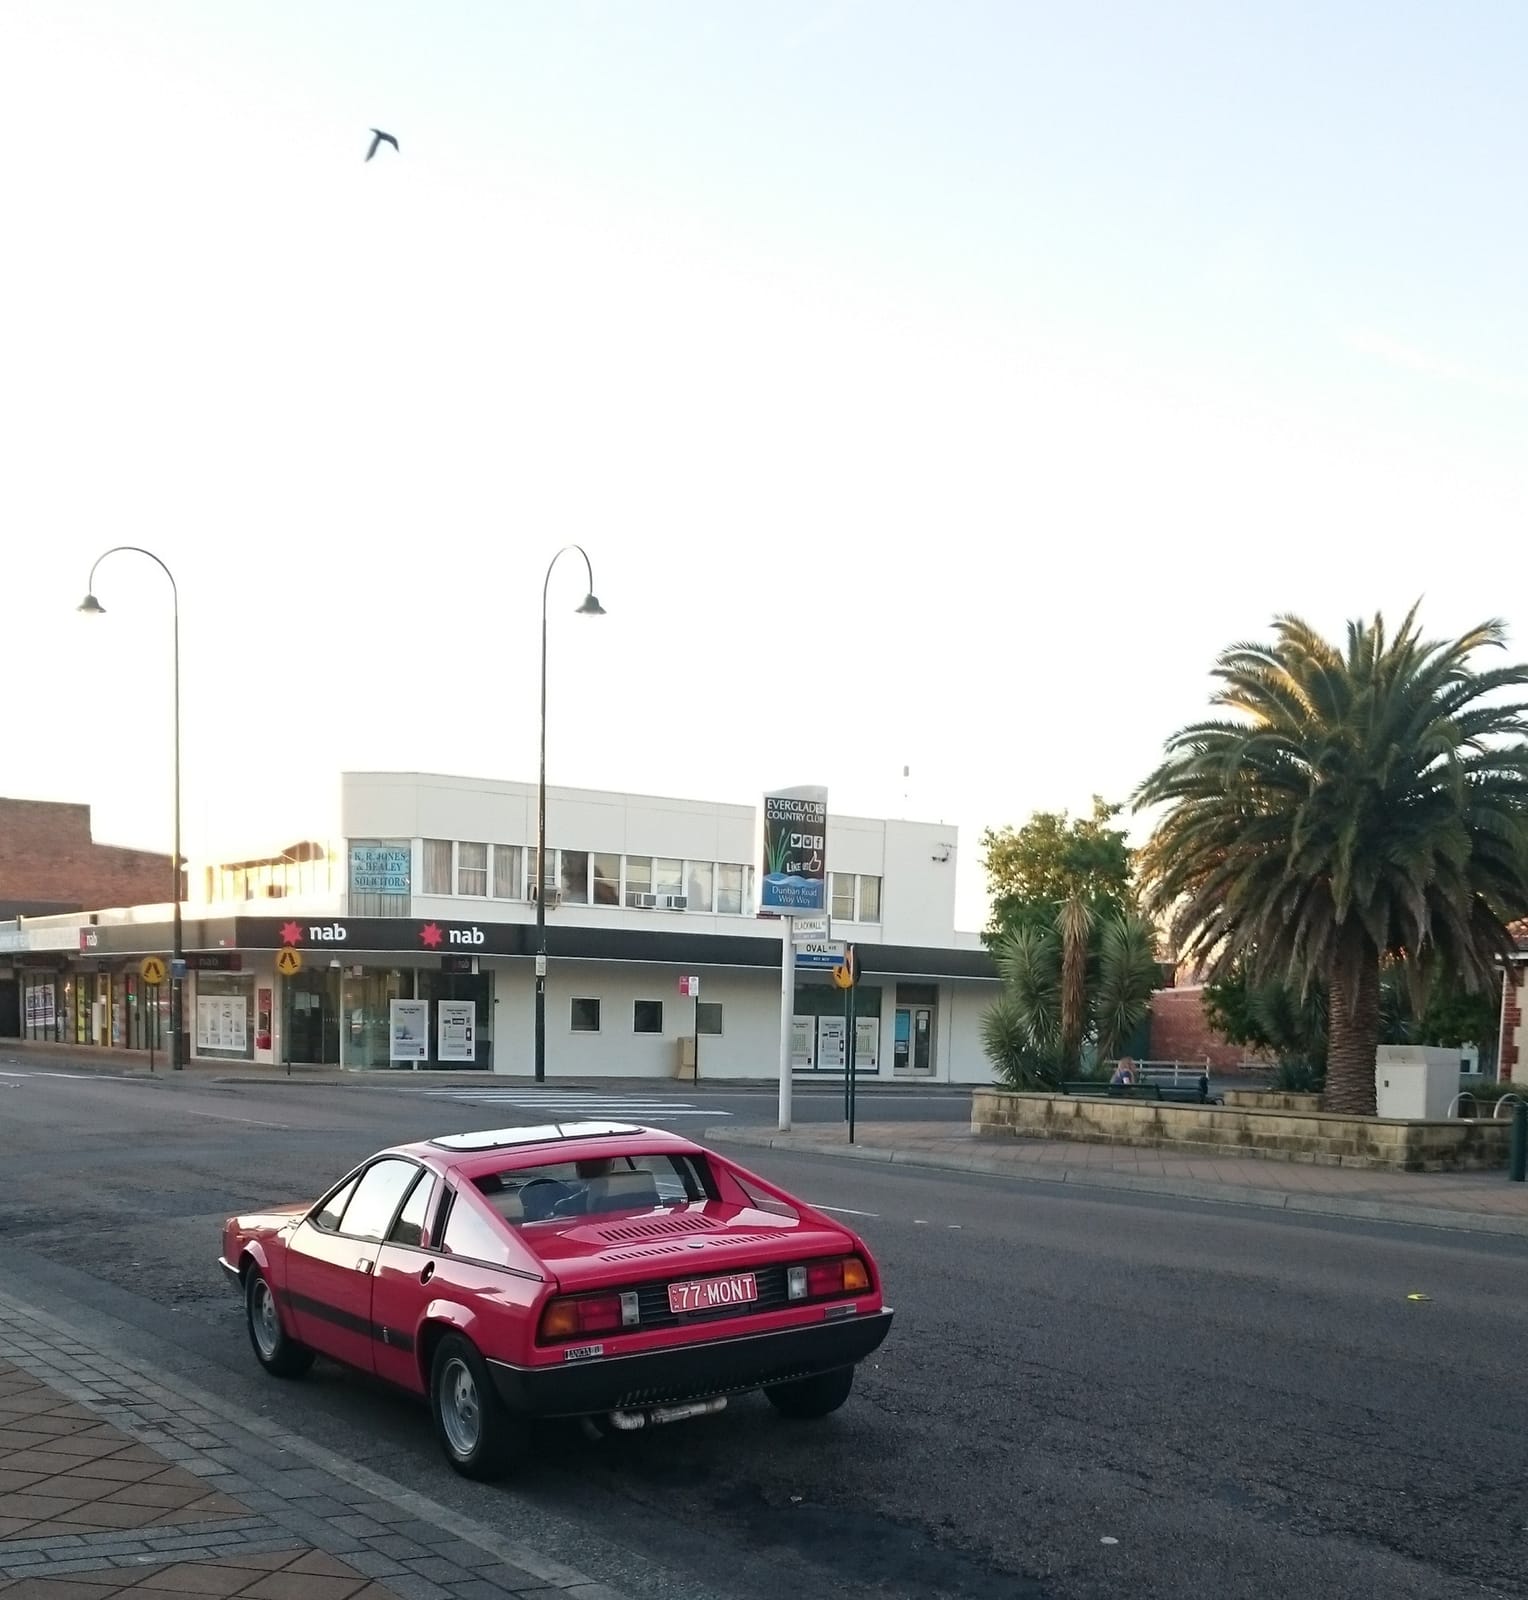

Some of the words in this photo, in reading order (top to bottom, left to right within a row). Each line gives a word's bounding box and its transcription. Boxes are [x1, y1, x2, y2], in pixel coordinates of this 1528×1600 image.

[767, 799, 825, 814] EVERGLADES
[767, 811, 805, 822] COUNTRY
[806, 814, 824, 824] CLUB
[376, 852, 406, 861] JONES
[354, 877, 406, 887] SOLICITORS
[801, 888, 817, 897] Road
[779, 895, 795, 905] Woy
[796, 896, 810, 906] Woy
[309, 923, 347, 941] nab
[449, 927, 485, 945] nab
[806, 944, 827, 953] OVAL
